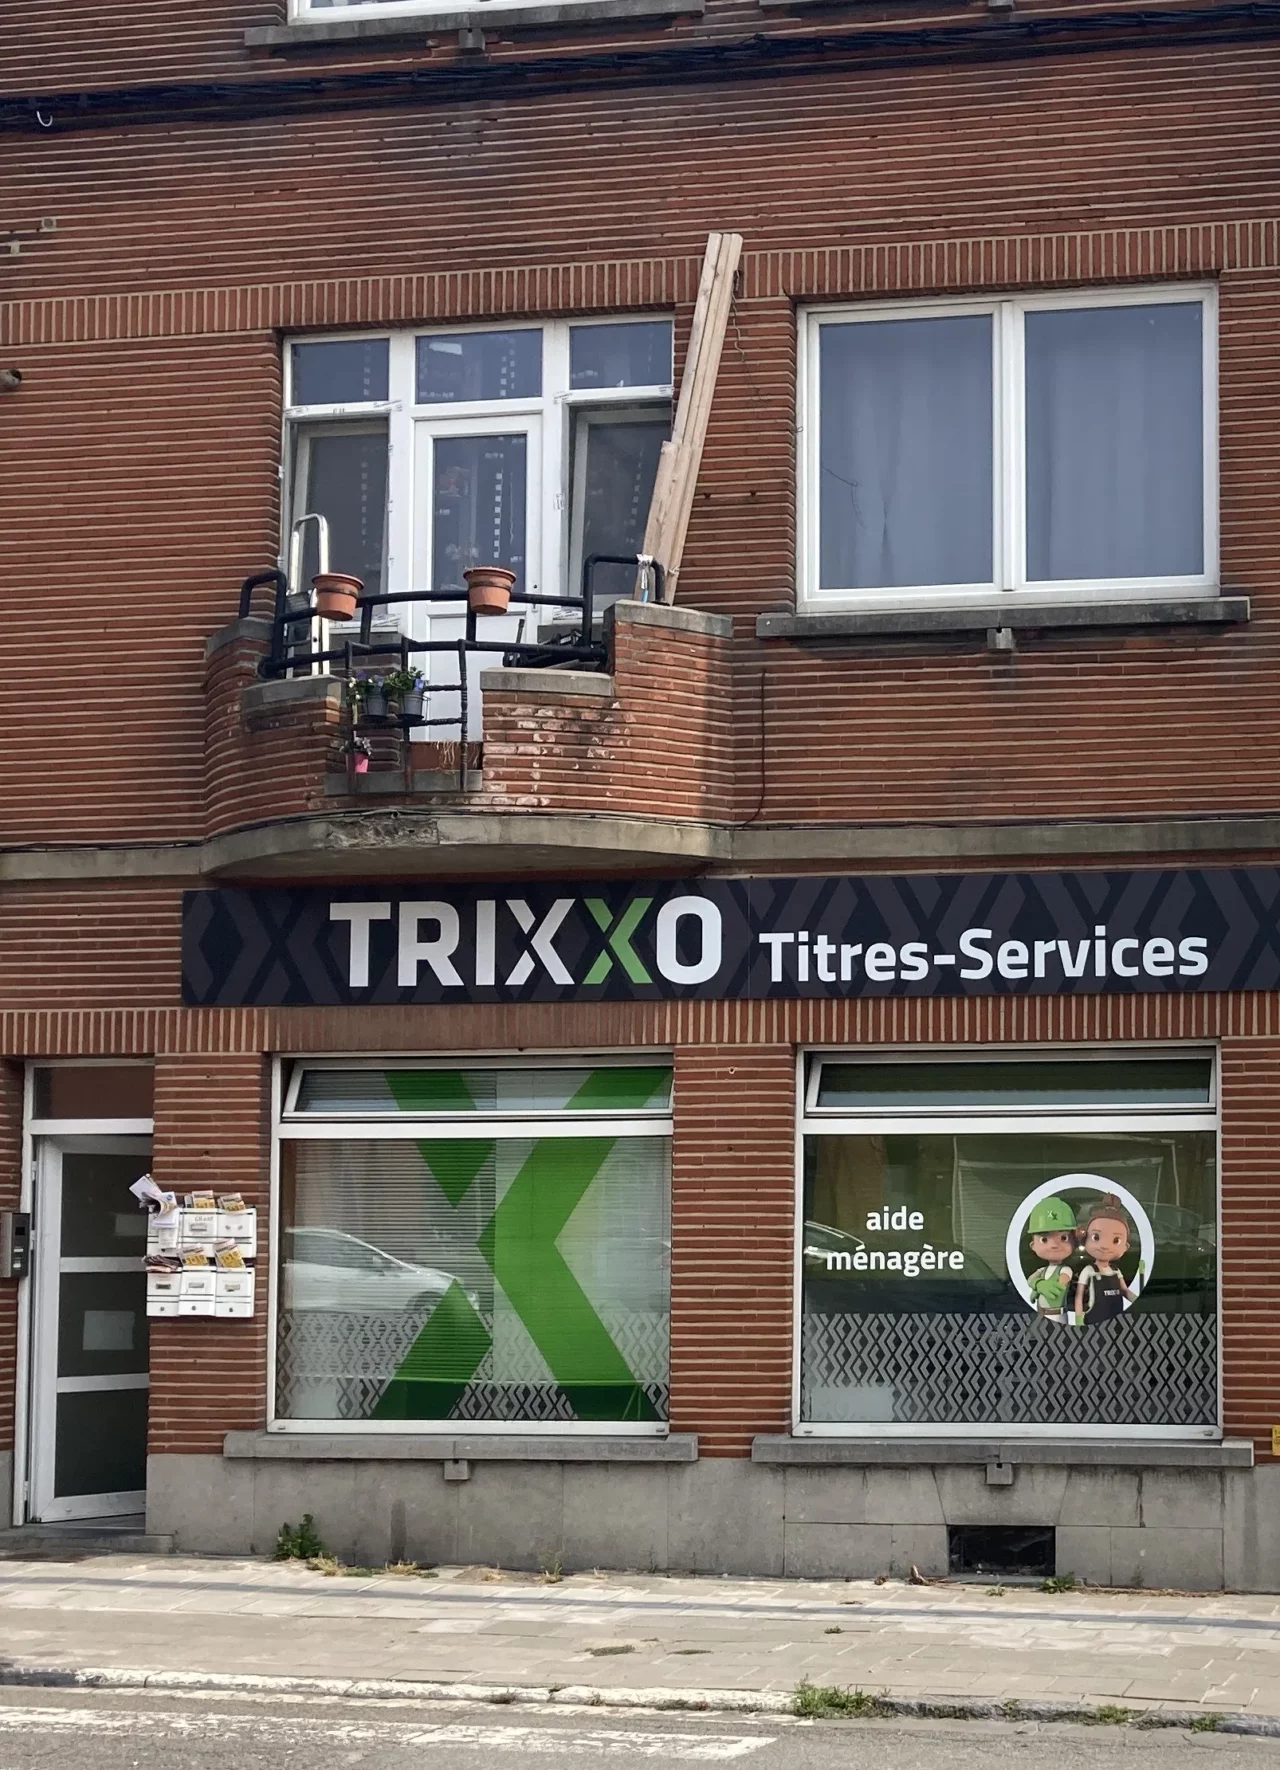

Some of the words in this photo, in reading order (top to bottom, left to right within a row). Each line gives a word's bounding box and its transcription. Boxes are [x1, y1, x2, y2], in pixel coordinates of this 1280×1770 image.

[329, 895, 723, 987] TRIXXO
[758, 925, 1209, 983] Titres-Services
[865, 1205, 924, 1231] aide
[825, 1244, 964, 1276] ménagère
